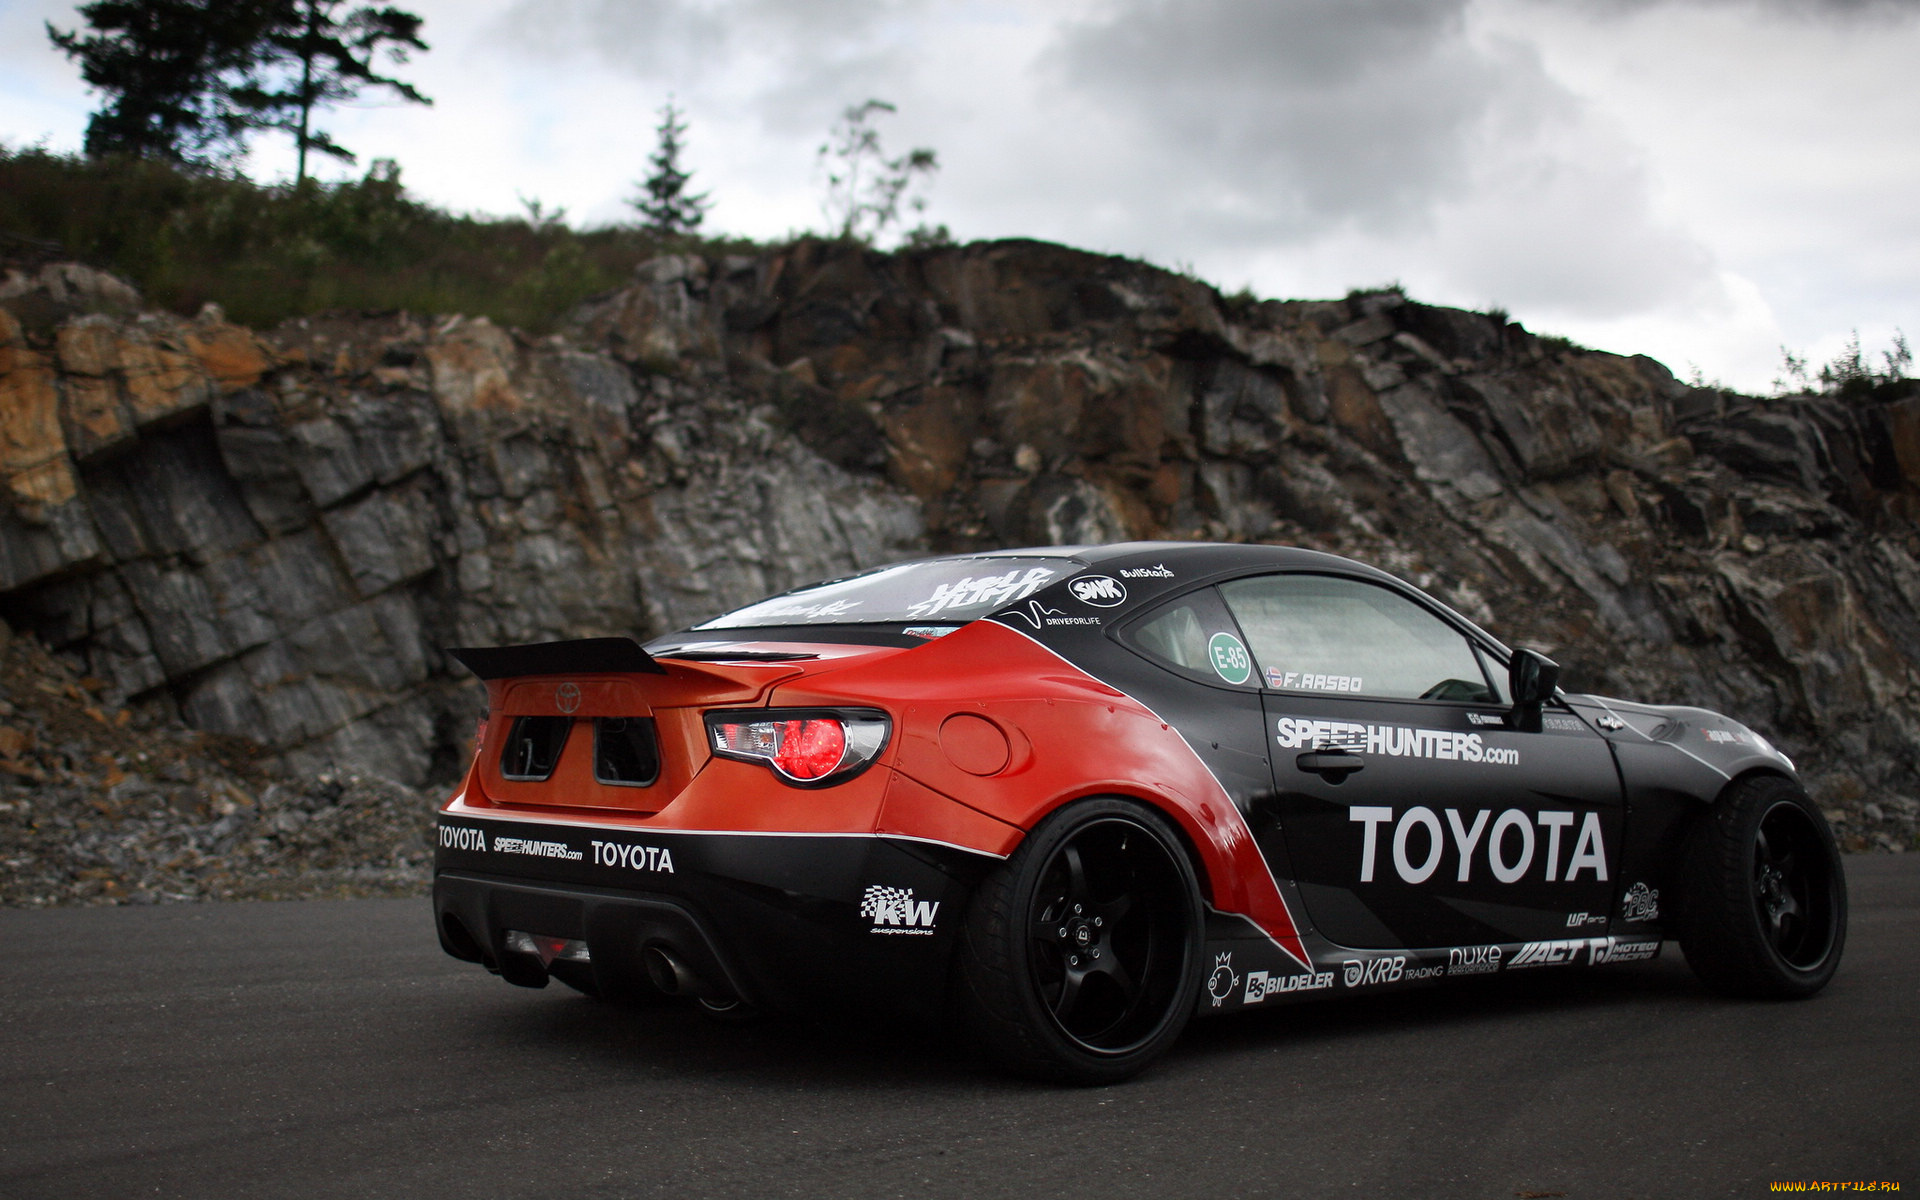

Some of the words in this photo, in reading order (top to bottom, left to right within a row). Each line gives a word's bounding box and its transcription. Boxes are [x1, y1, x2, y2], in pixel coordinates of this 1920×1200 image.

[1214, 646, 1247, 669] E-85
[1276, 717, 1519, 765] SPEEDHUNTERS.com
[439, 825, 486, 852] TOYOTA
[493, 837, 583, 861] SPEEDHUNTERS.com
[1349, 805, 1608, 884] TOYOTA
[591, 841, 675, 874] TOYOTA
[870, 928, 934, 936] suspensions
[1449, 945, 1502, 966] nuke
[1607, 952, 1655, 962] RACING
[1613, 942, 1658, 952] MOTEGI
[1362, 956, 1406, 985] KRB
[1405, 966, 1444, 980] TRADING
[1265, 971, 1334, 995] BILDELER
